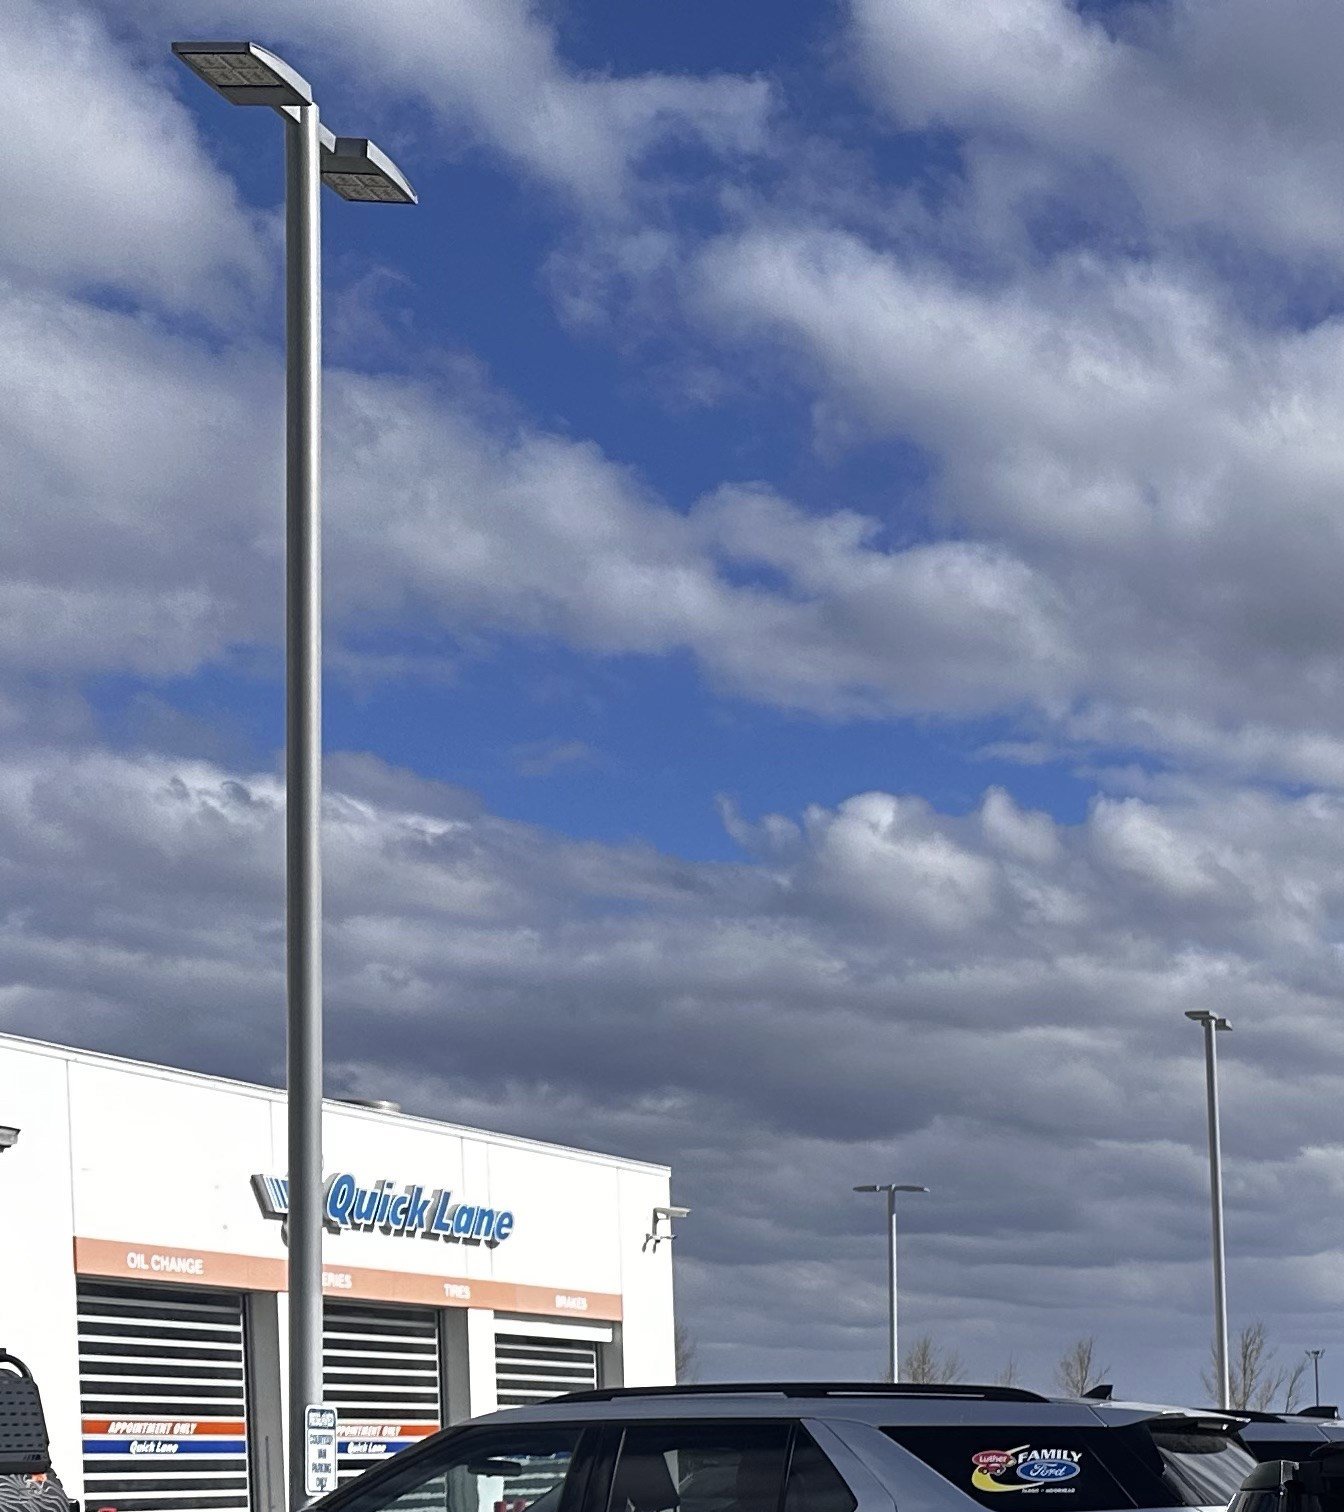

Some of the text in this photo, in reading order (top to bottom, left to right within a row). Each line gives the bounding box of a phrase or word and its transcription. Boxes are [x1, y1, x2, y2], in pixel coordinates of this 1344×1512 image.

[326, 1173, 514, 1241] Quick Lane
[126, 1251, 204, 1275] OIL CHANGE
[443, 1283, 471, 1300] TIRES
[107, 1421, 198, 1435] APPOINTMENT ONLY
[337, 1425, 381, 1436] PPOINTMENT
[129, 1440, 179, 1454] Quick Lane
[979, 1455, 1008, 1463] Luther
[1017, 1448, 1083, 1464] FAMILY
[1029, 1463, 1067, 1477] Ford
